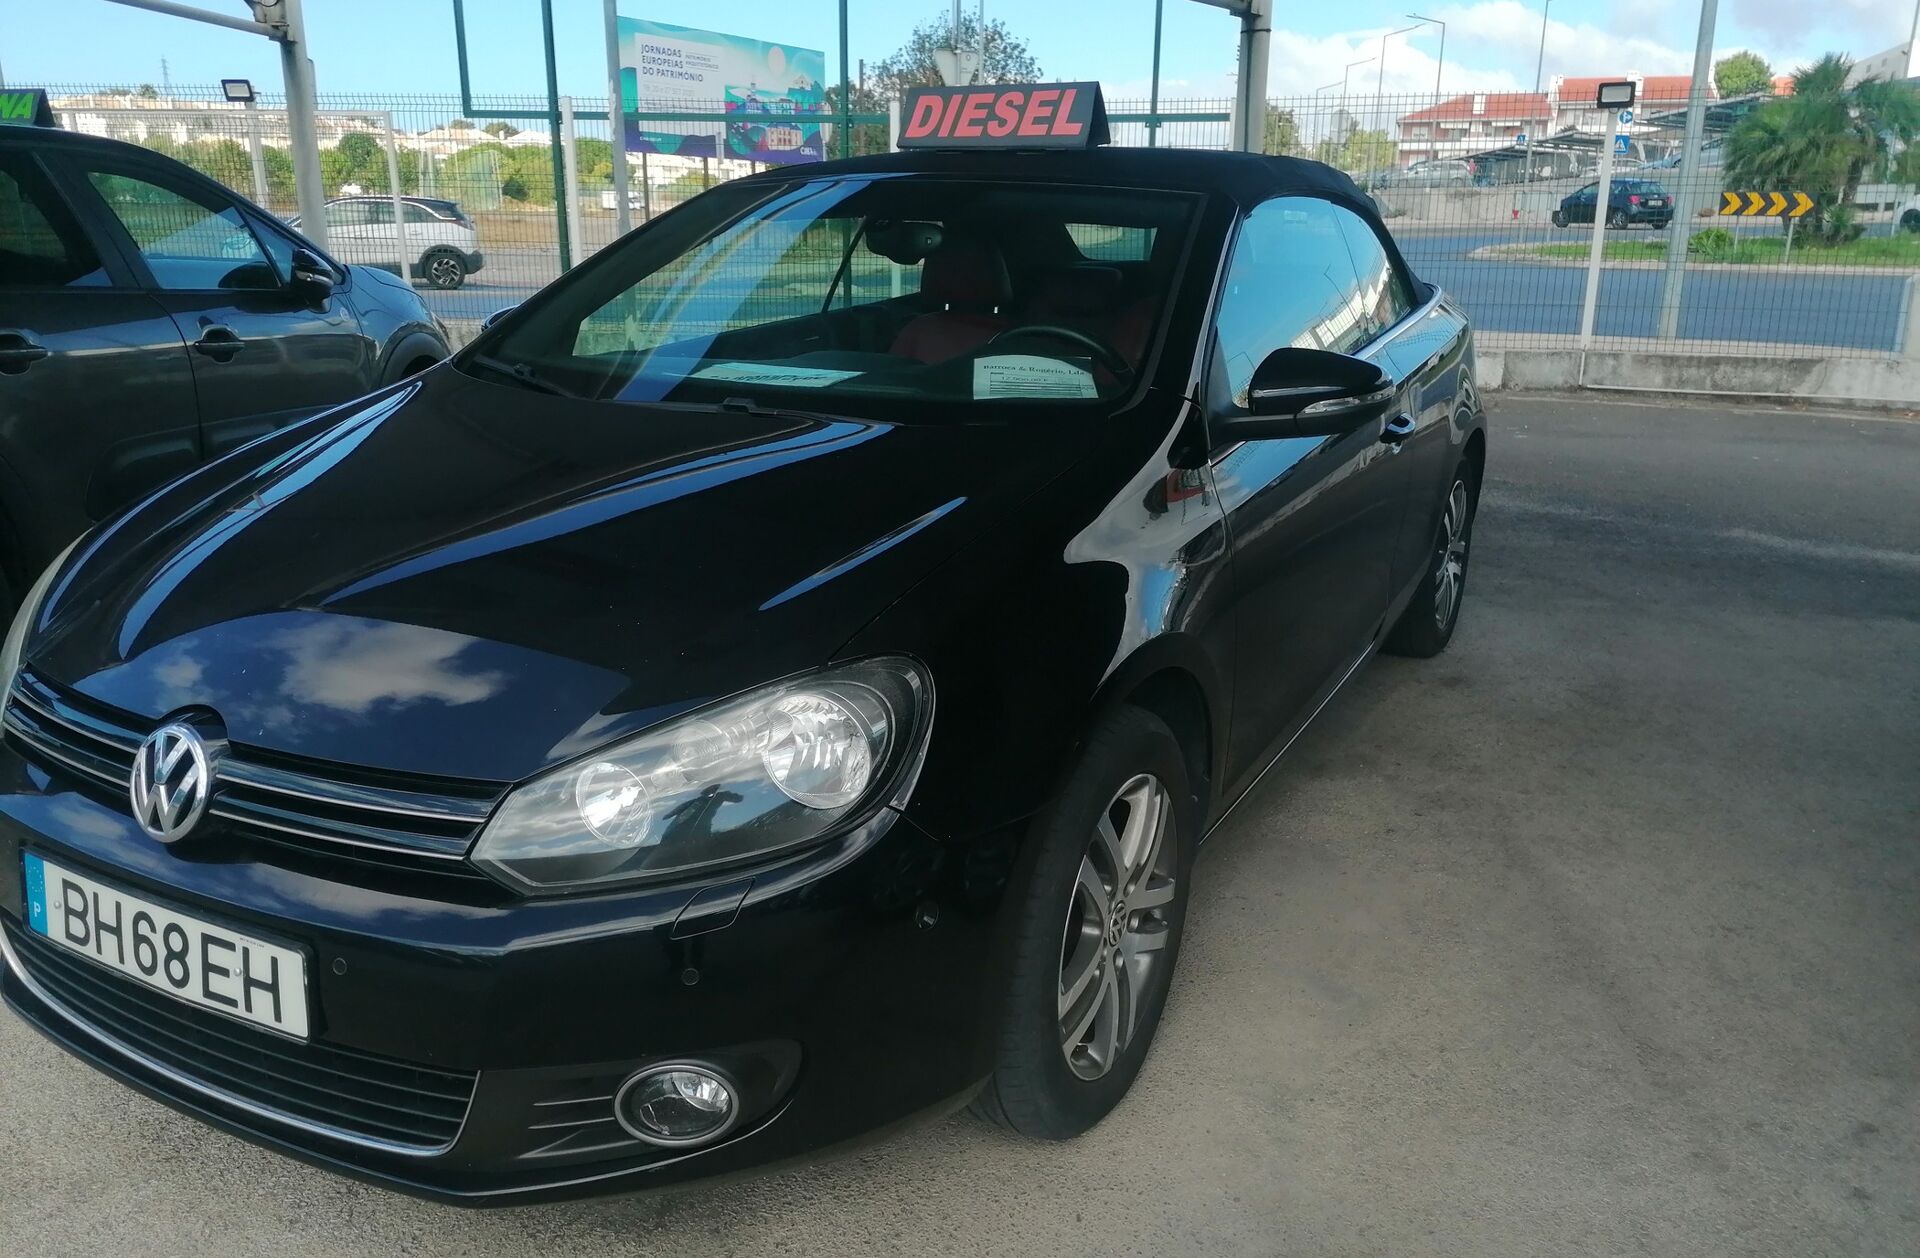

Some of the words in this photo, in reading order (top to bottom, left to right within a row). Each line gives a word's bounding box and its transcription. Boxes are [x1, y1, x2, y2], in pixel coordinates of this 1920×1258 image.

[641, 44, 682, 58] JORNADAS
[642, 55, 684, 69] EUROPEIAS
[642, 66, 655, 76] DO
[656, 67, 704, 82] PATRIMÓNIO
[904, 88, 1084, 138] DIESEL
[32, 902, 41, 917] P
